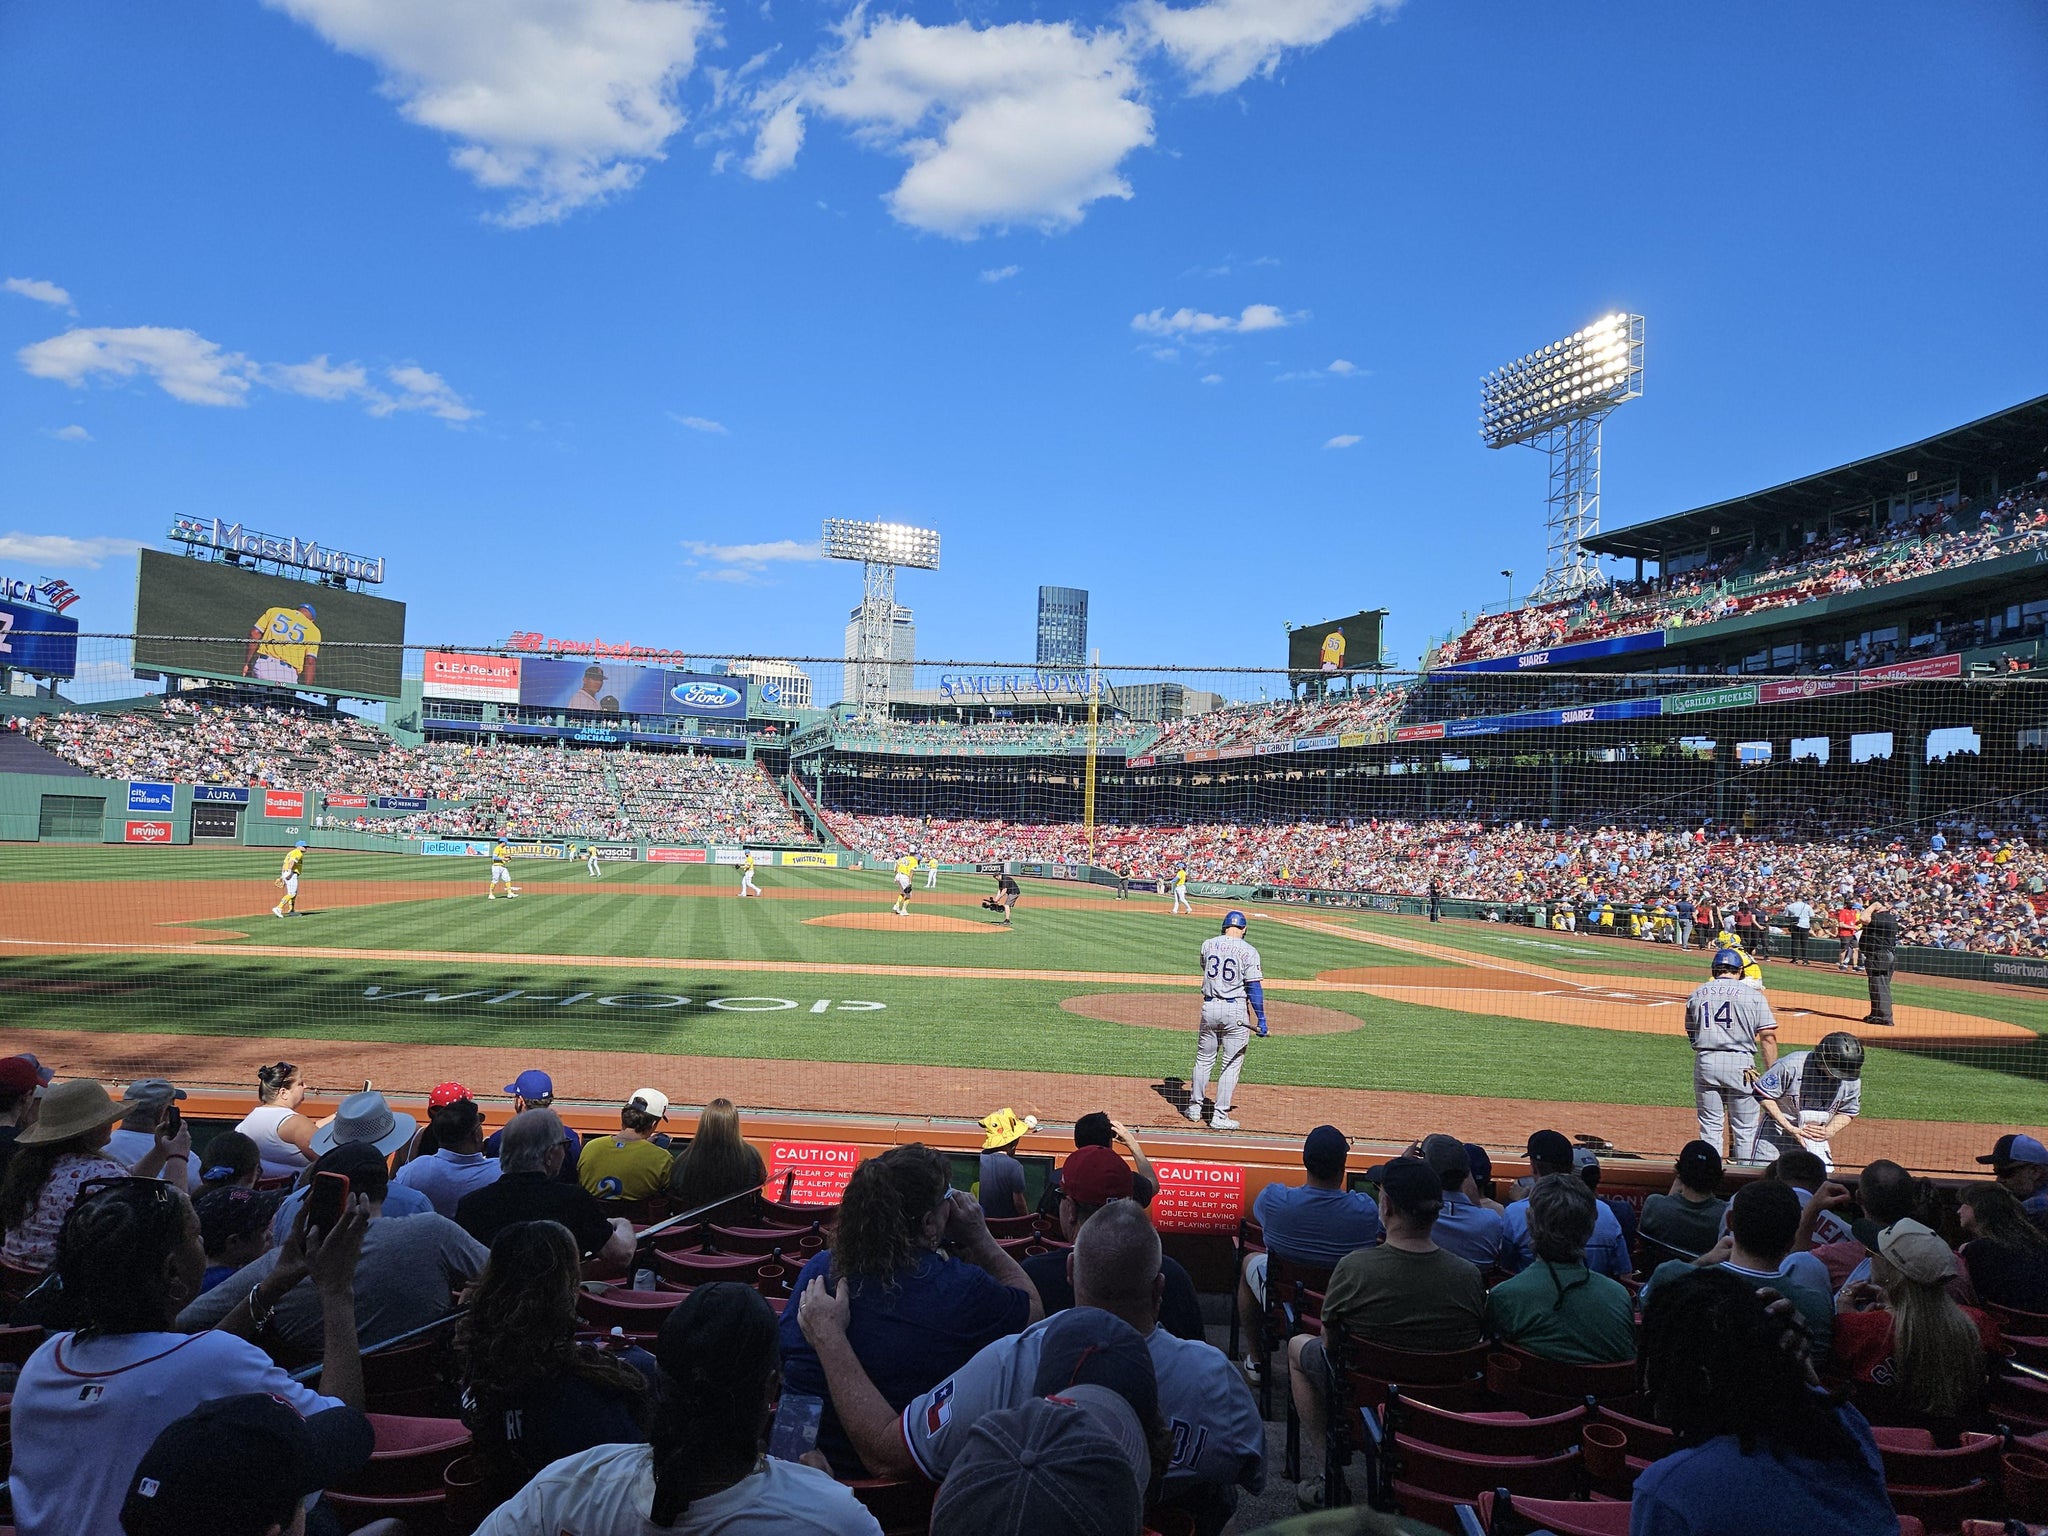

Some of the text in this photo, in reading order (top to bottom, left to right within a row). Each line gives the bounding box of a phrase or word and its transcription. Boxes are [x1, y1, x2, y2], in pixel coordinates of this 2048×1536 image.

[212, 518, 386, 584] MassMutual
[271, 613, 309, 644] 55
[1327, 637, 1341, 651] 55
[548, 637, 685, 665] new balance
[1518, 652, 1550, 668] SUAREZ
[434, 661, 511, 679] CLEAResult
[940, 670, 1107, 698] SAMUEL ADAMS
[1777, 685, 1804, 695] Ninety
[1817, 680, 1836, 690] Nine
[684, 686, 729, 705] Ford
[1684, 691, 1753, 708] GRILLO'S PICKLES
[1561, 708, 1595, 723] SUAREZ
[479, 723, 505, 732] SUAREZ
[580, 727, 612, 736] ANGRY
[574, 733, 618, 743] ORCHARD
[680, 736, 702, 744] SUAREZ
[130, 795, 160, 804] cruises
[131, 789, 146, 798] city
[266, 798, 303, 808] Safelite
[342, 798, 367, 806] TICKET
[132, 827, 165, 837] IRVING
[285, 826, 299, 835] 420
[425, 842, 461, 855] jetBlue
[503, 845, 563, 857] GRANITE CITY
[596, 847, 632, 857] wasabi
[793, 855, 816, 864] TWISTED
[1207, 954, 1237, 983] 36
[1701, 1000, 1734, 1030] 14
[775, 1147, 855, 1163] CAUTION!
[795, 1169, 821, 1178] CLEAR
[823, 1170, 835, 1178] OF
[838, 1171, 853, 1179] NET
[1158, 1167, 1240, 1184] CAUTION!
[774, 1179, 785, 1187] AN
[793, 1179, 805, 1187] BE
[806, 1180, 832, 1188] ALERT
[1157, 1188, 1240, 1201] STAY CLEAR OF NET
[1158, 1199, 1238, 1210] AND BE ALERT FOR
[1160, 1209, 1235, 1220] OBJECTS LEAVING
[1158, 1219, 1237, 1231] THE PLAYING FIELD
